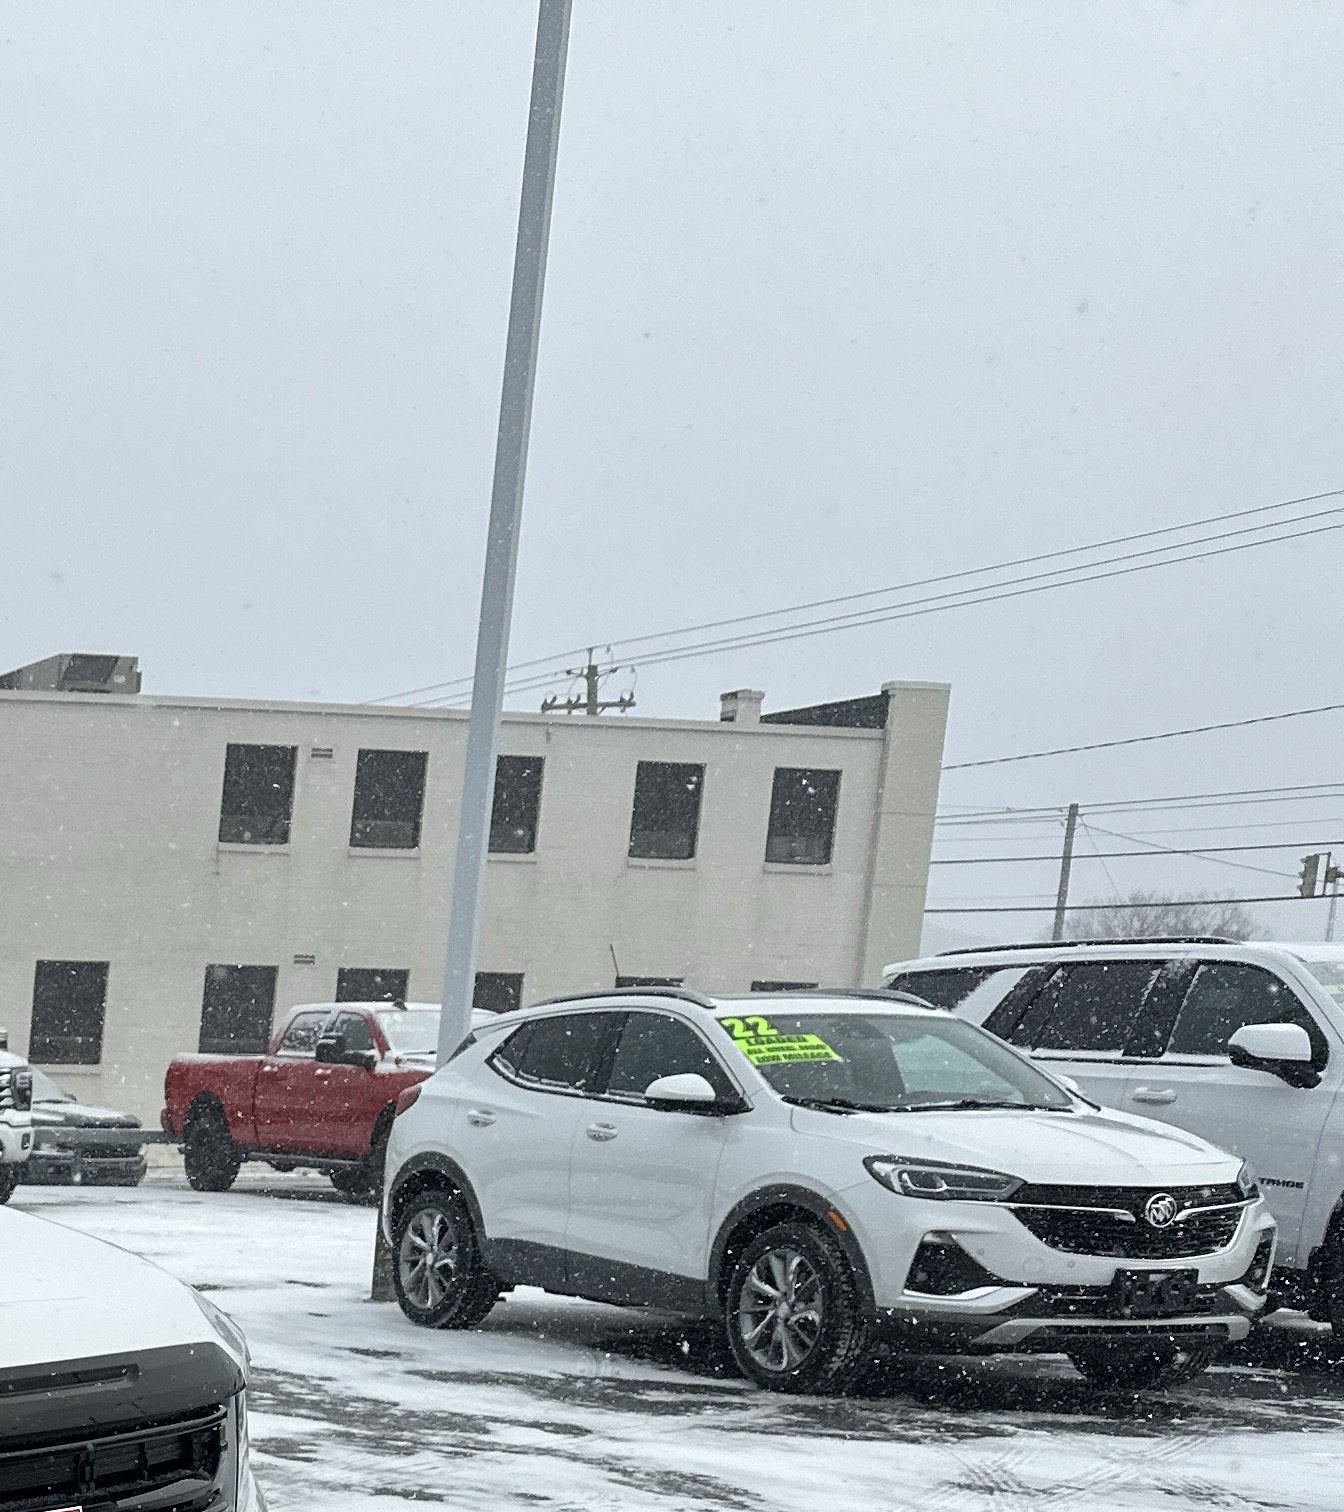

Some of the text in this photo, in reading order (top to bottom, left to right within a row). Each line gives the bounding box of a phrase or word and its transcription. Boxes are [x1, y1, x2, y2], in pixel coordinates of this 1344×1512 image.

[720, 1015, 779, 1038] 22
[746, 1036, 808, 1046] LOADED
[1258, 1177, 1305, 1189] TAHOE
